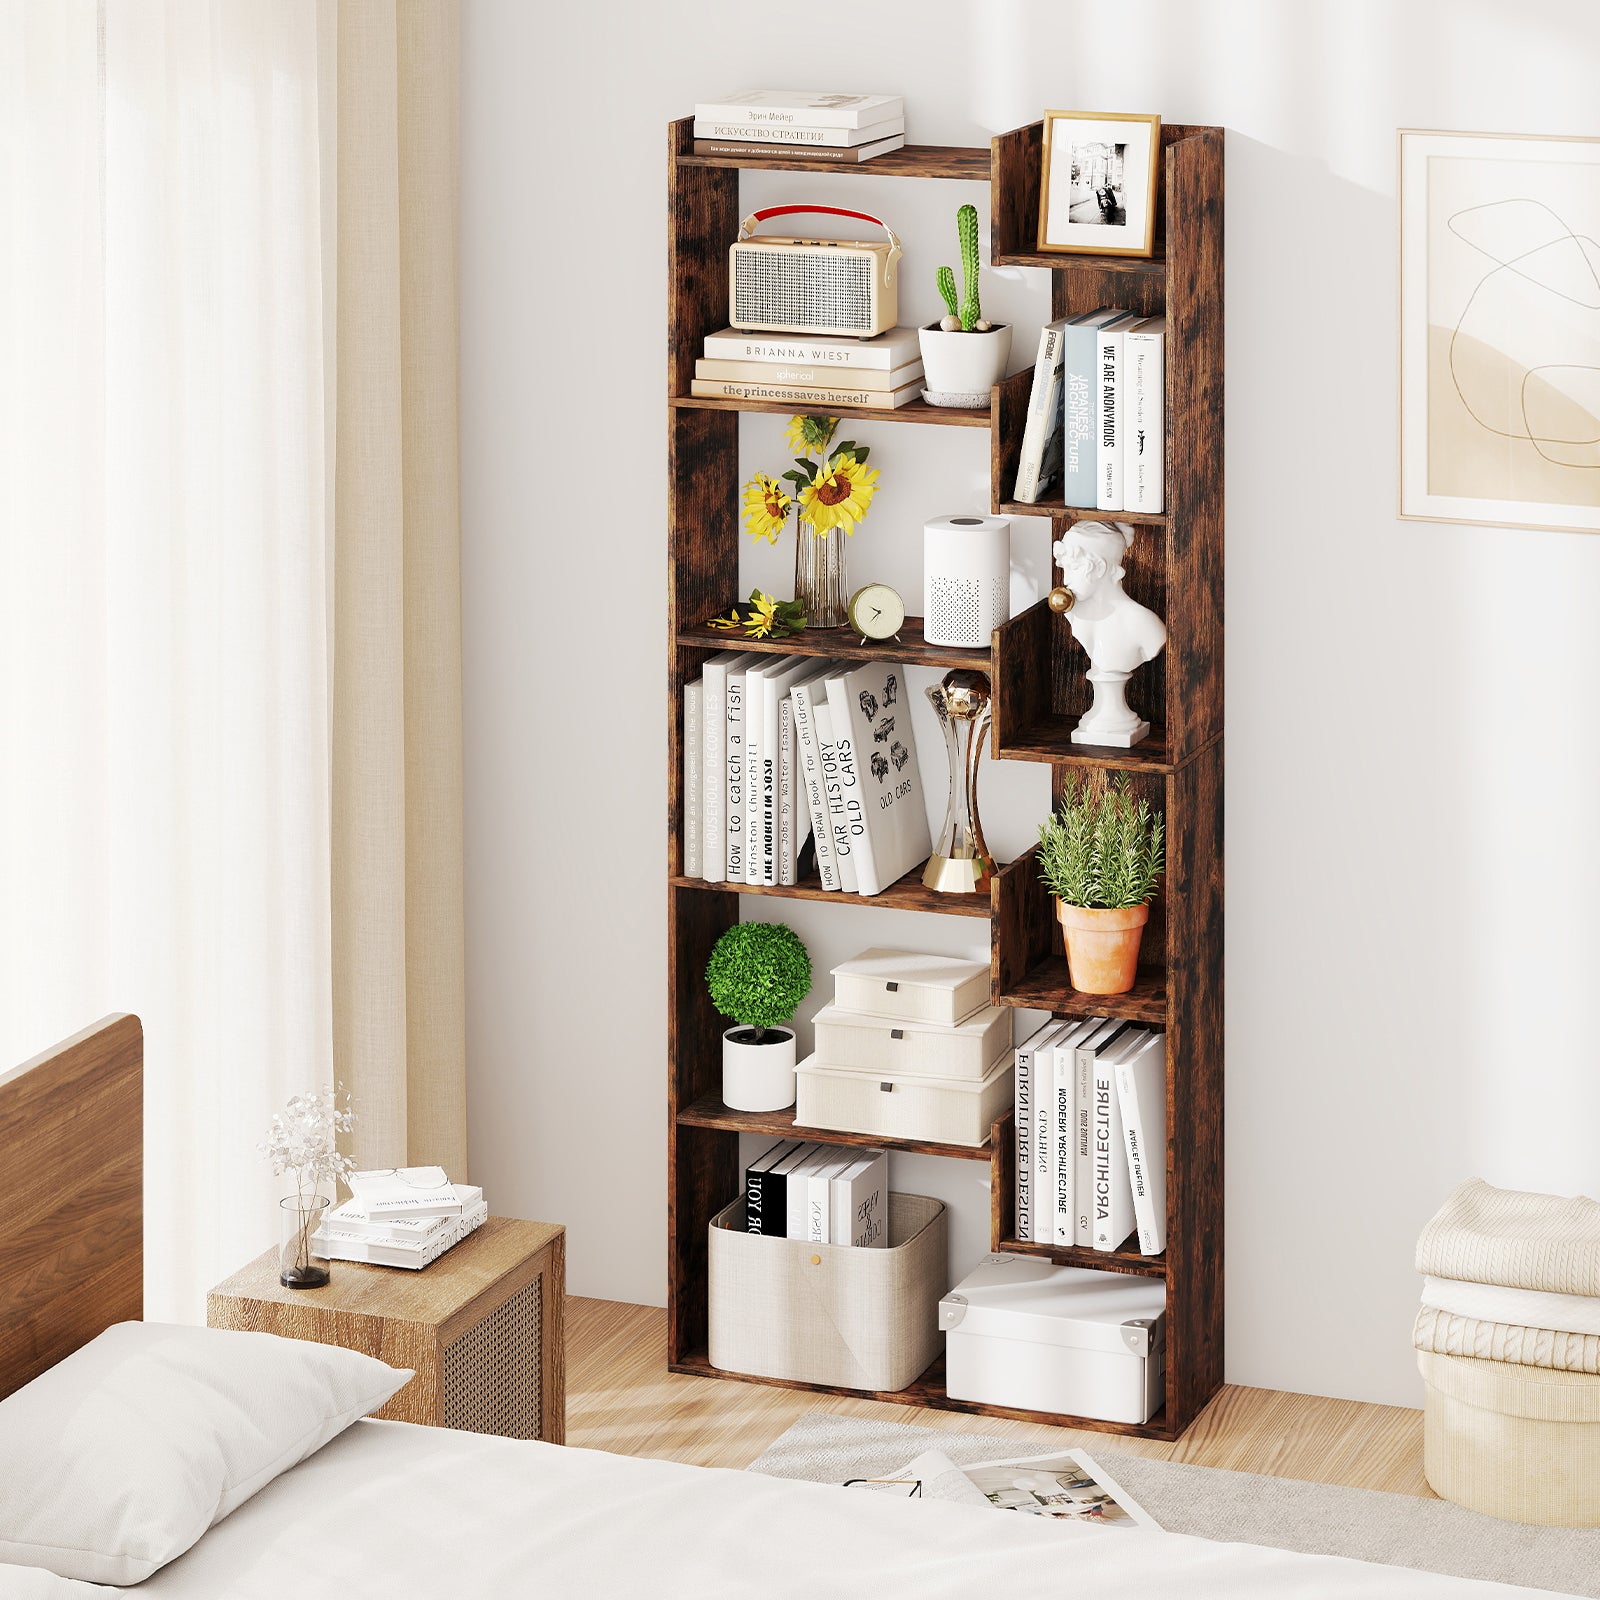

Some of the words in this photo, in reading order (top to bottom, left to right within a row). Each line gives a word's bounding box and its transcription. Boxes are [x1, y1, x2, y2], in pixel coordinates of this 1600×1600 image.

[748, 111, 767, 122] Эрин
[768, 111, 794, 123] Мейер
[714, 126, 770, 138] ИСКУССТВО
[772, 129, 825, 142] СТРАТЕГИИ
[746, 346, 805, 359] BRIANNA
[812, 350, 851, 362] WIEST
[1044, 331, 1057, 360] FRANK
[1103, 345, 1114, 361] WE
[776, 367, 814, 382] spherical
[1103, 363, 1114, 383] ARE
[722, 384, 742, 396] the
[828, 392, 870, 404] herself
[1077, 374, 1089, 441] JAPANESE
[1068, 372, 1078, 473] ARCHITECTURE
[1103, 386, 1114, 448] ANONYMOUS
[728, 684, 741, 723] fish
[796, 692, 811, 746] children
[706, 694, 718, 768] DECORATES
[731, 735, 741, 744] a
[781, 703, 789, 753] Isaacson
[748, 743, 758, 813] Churchill
[781, 758, 789, 796] Walter
[820, 742, 844, 815] HISTORY
[836, 738, 857, 788] CARS
[728, 755, 741, 804] catch
[809, 779, 821, 806] Book
[880, 791, 894, 810] OLD
[895, 778, 912, 800] CARS
[706, 776, 718, 849] HOUSEHOLD
[781, 801, 790, 814] by
[847, 800, 865, 836] OLD
[730, 815, 741, 833] to
[781, 821, 789, 845] Jobs
[813, 812, 825, 840] DRAW
[834, 823, 851, 856] CAR
[728, 846, 741, 875] How
[748, 819, 758, 877] Winston
[820, 845, 828, 858] TO
[781, 851, 789, 882] Steve
[820, 866, 834, 886] HOW
